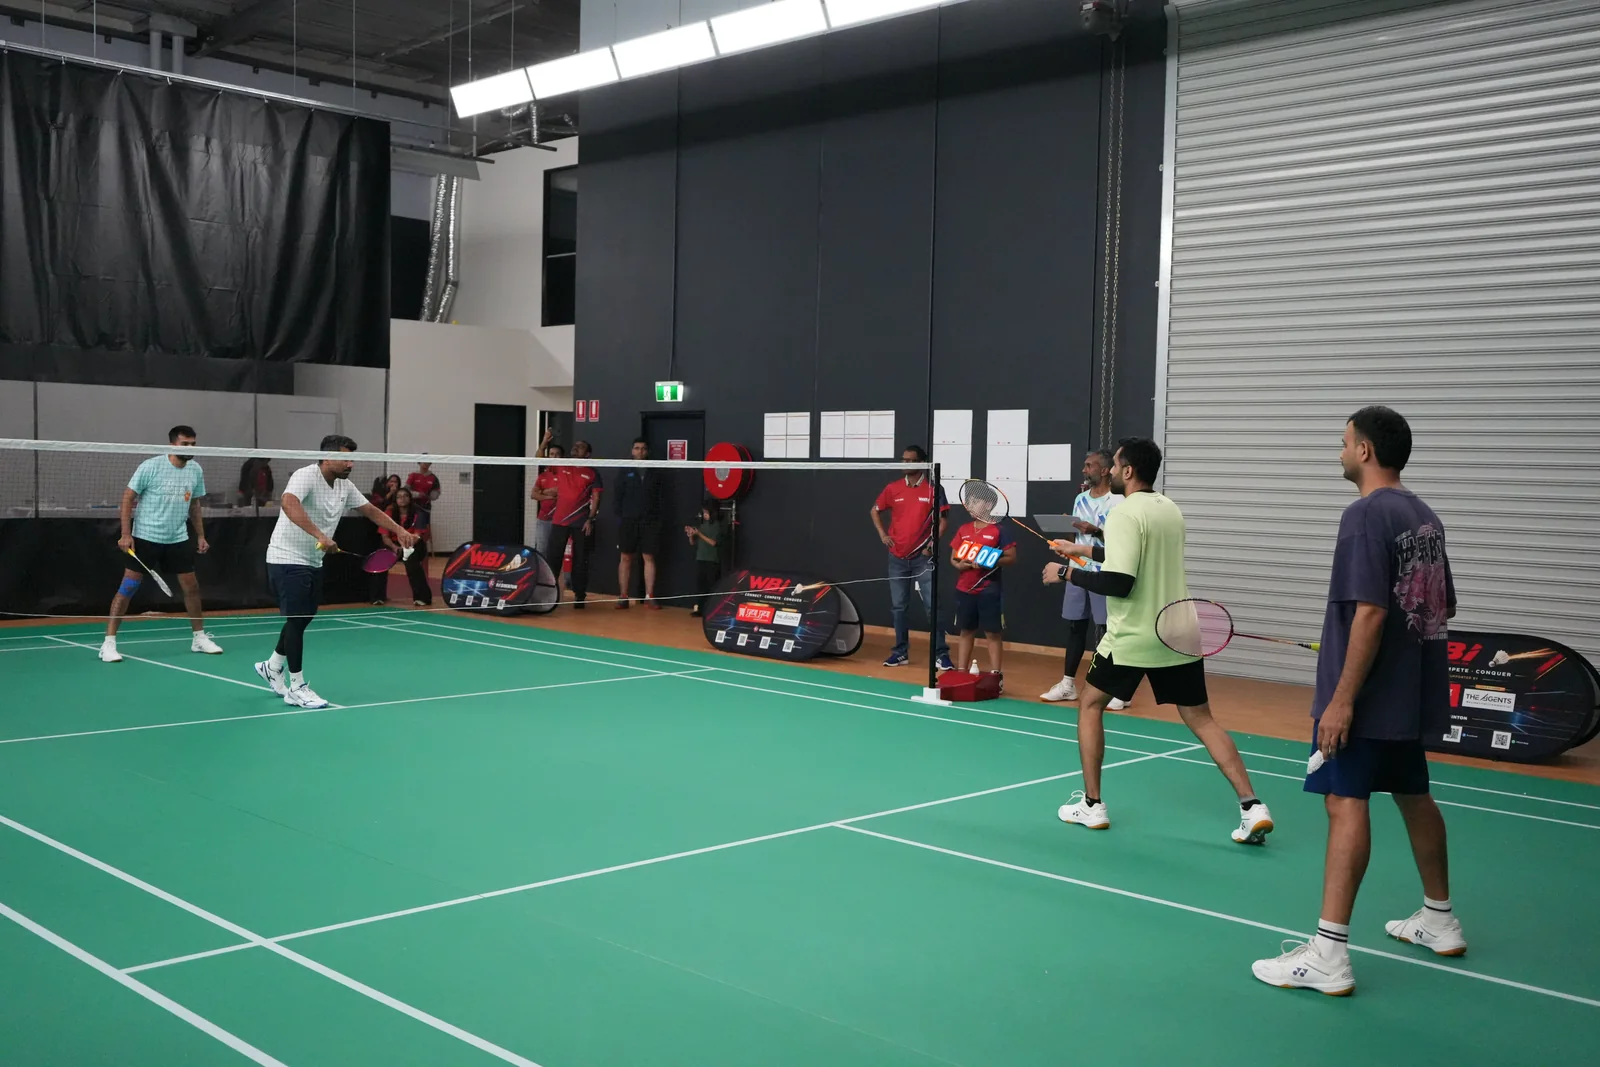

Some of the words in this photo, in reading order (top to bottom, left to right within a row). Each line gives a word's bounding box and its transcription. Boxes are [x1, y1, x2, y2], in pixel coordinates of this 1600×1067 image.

[957, 543, 979, 561] 06
[976, 549, 999, 567] 00
[1447, 641, 1484, 662] Bi
[1475, 669, 1512, 677] CONQUER
